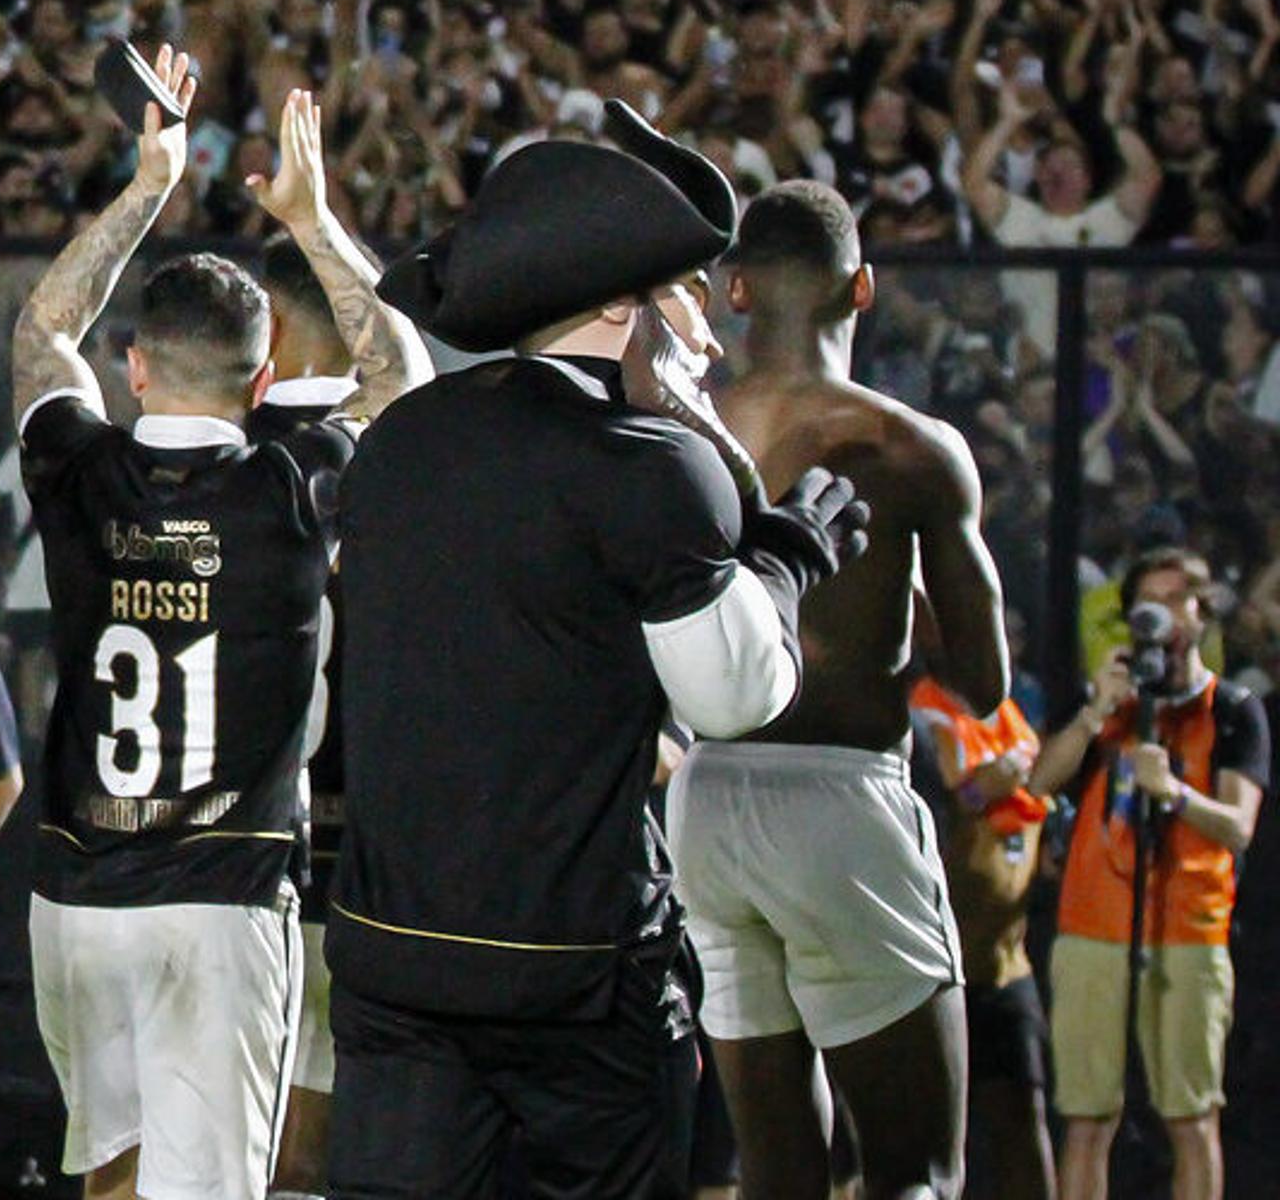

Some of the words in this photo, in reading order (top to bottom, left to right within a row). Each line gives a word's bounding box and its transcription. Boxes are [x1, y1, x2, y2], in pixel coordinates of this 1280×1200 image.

[162, 519, 211, 534] VASCO
[111, 579, 211, 623] ROSSI
[95, 623, 221, 799] 31
